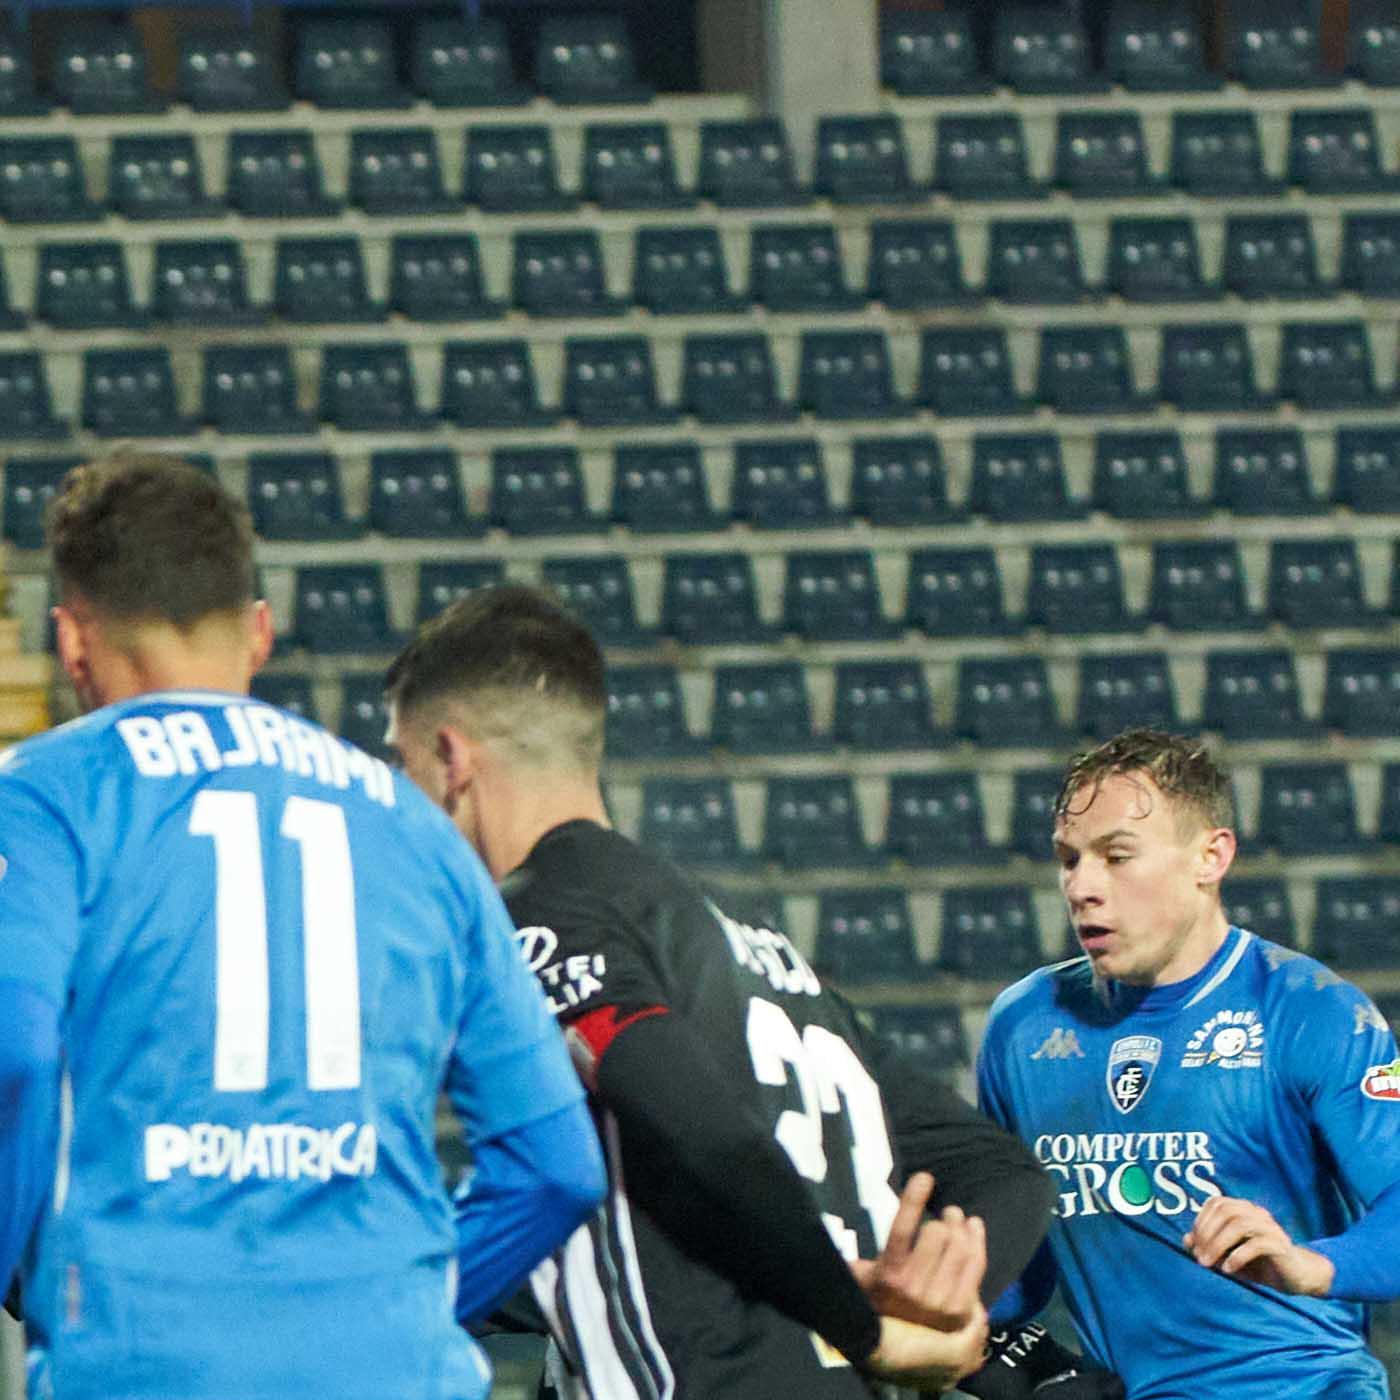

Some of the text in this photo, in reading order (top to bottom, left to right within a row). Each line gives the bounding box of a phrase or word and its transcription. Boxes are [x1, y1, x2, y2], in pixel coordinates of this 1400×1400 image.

[116, 704, 396, 808] BAJRAMI
[189, 790, 361, 1092] 11
[145, 1122, 377, 1182] PEDIATRICA
[1034, 1131, 1214, 1164] COMPUTER
[1045, 1161, 1222, 1218] GROSS
